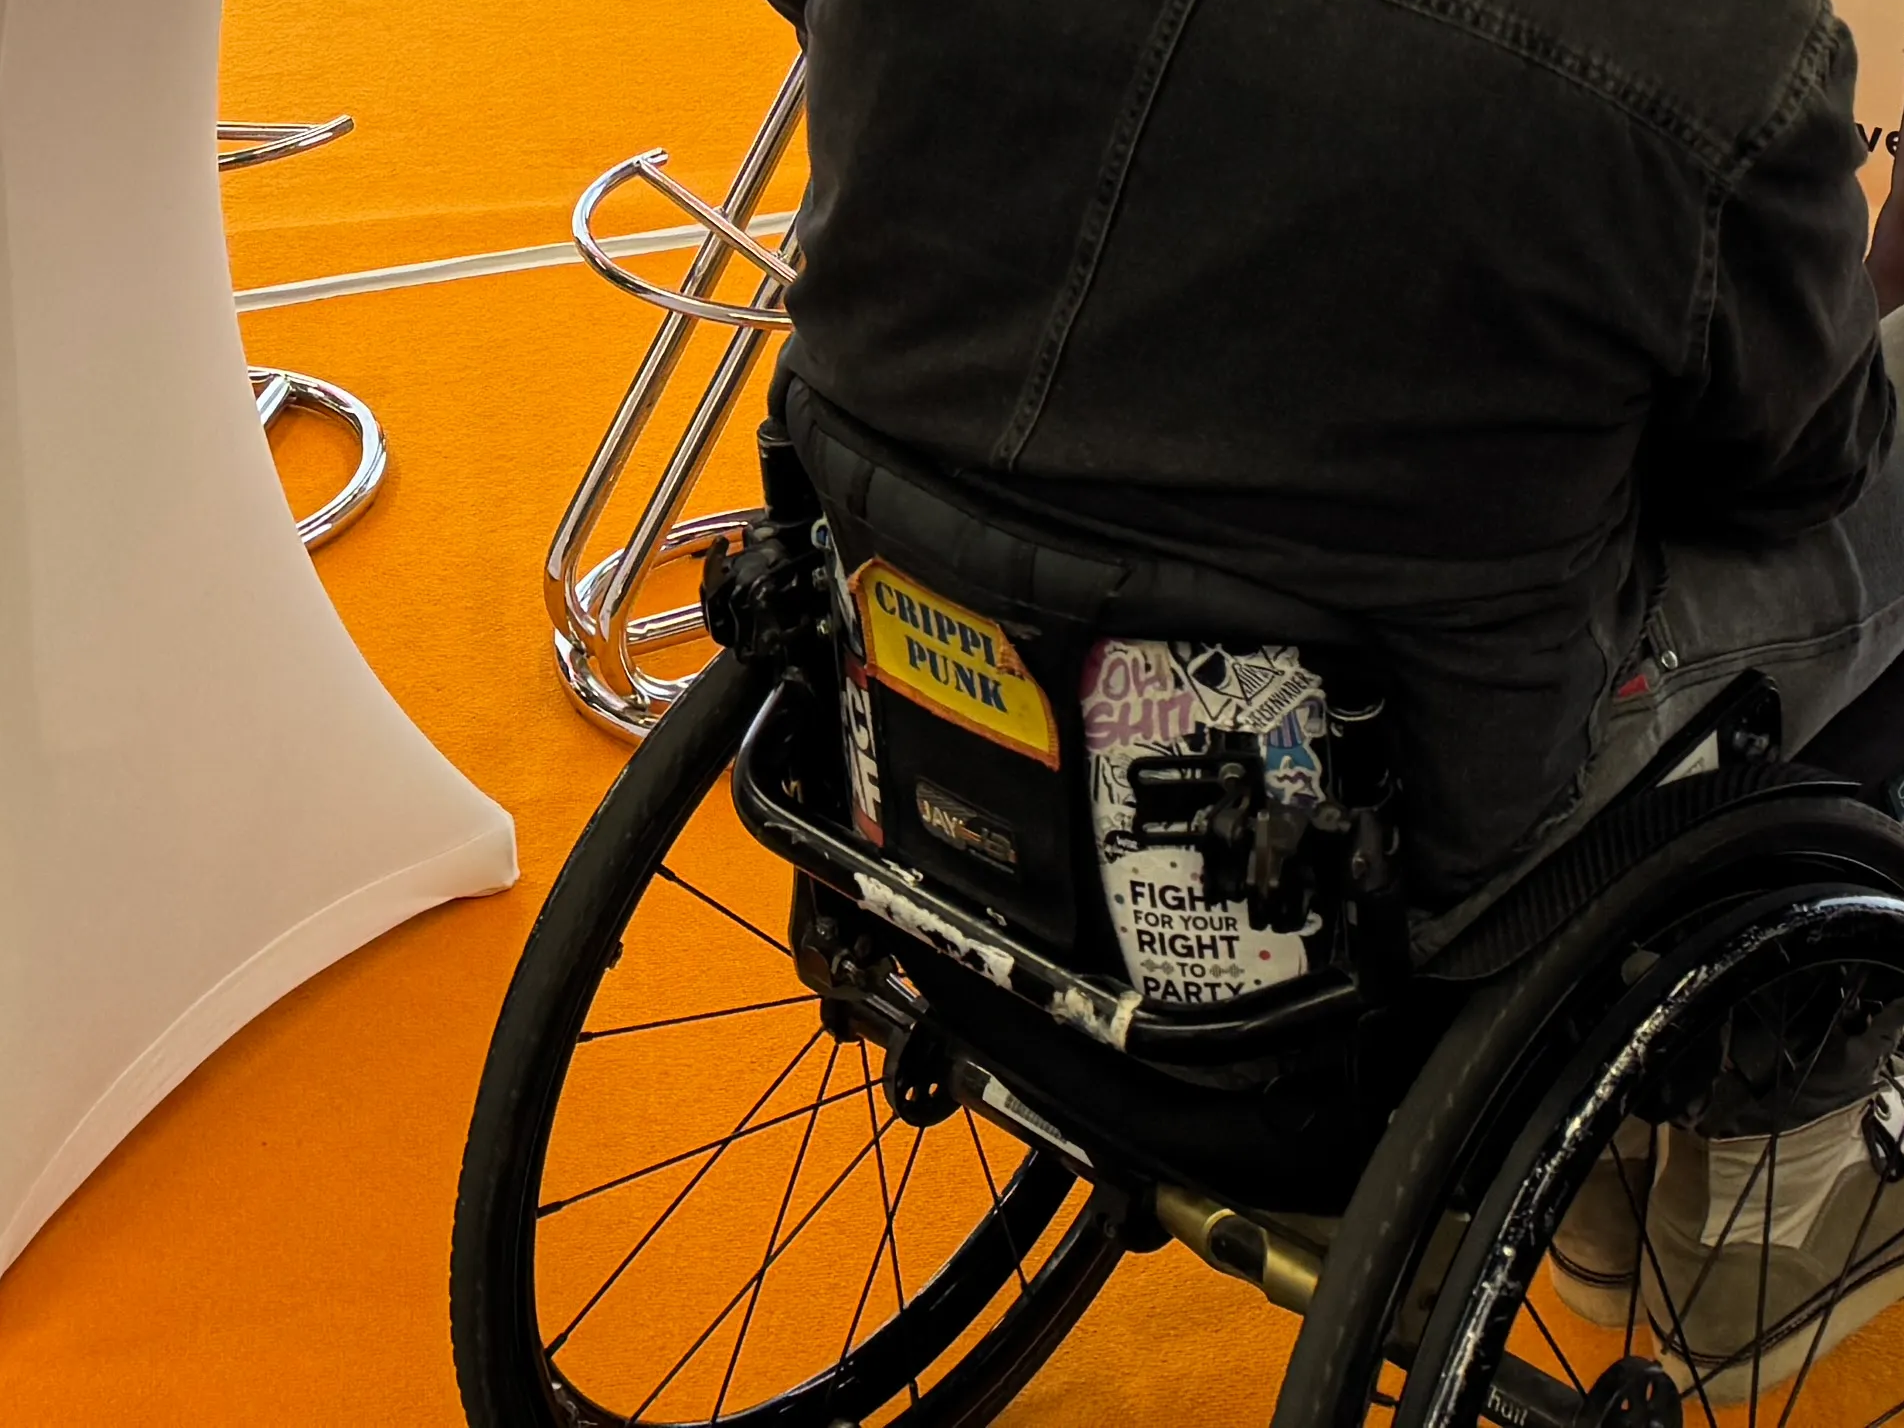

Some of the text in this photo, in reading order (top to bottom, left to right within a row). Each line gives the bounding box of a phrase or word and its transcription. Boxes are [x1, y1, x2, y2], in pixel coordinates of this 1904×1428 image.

[904, 634, 1009, 714] PUNK
[1133, 909, 1239, 932] FOR YOUR
[1136, 928, 1241, 960] RIGHT
[1175, 961, 1207, 979] TO
[1143, 975, 1246, 1004] PARTY
